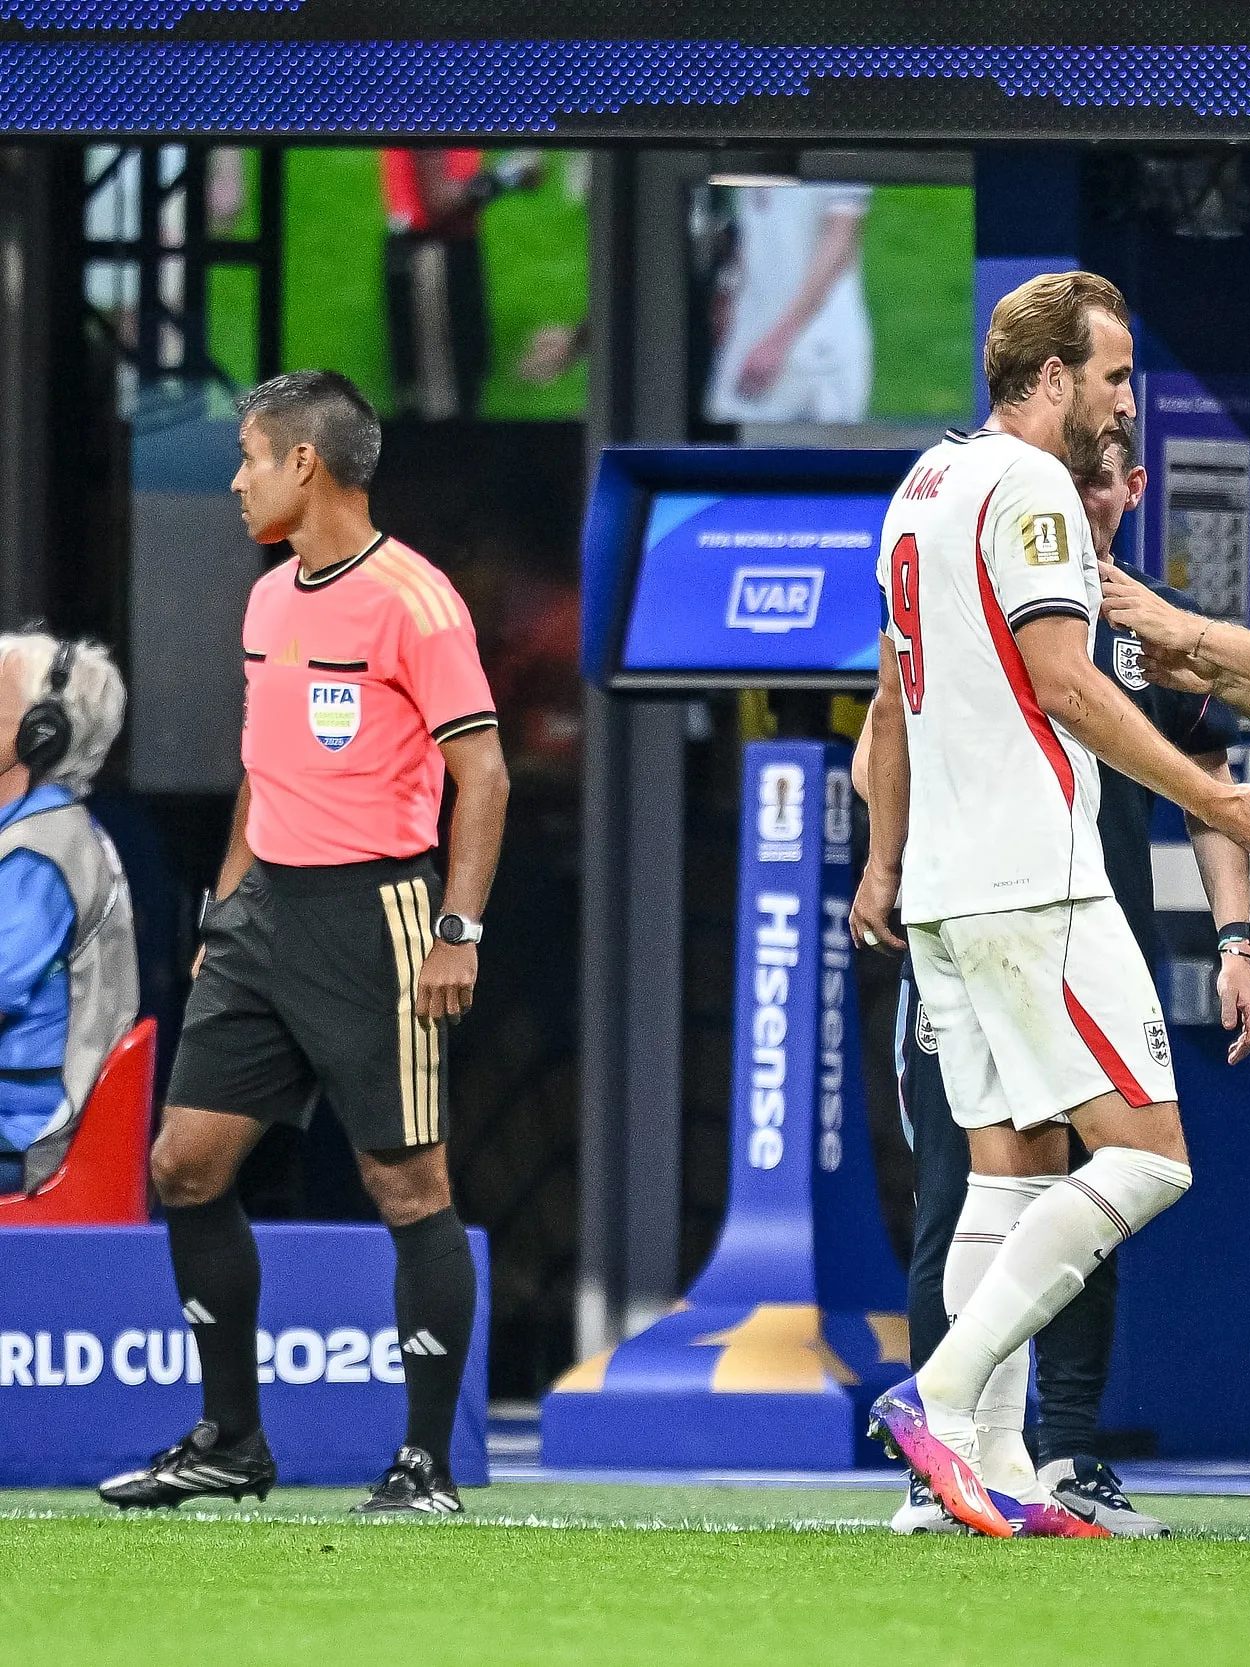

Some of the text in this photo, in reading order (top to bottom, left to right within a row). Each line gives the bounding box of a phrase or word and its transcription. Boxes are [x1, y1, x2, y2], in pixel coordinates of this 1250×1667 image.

[744, 584, 809, 613] VAR
[891, 533, 925, 715] 9
[312, 687, 355, 704] FIFA
[749, 893, 802, 1171] Hisense
[818, 896, 851, 1174] Hisense
[0, 1330, 103, 1386] RLD
